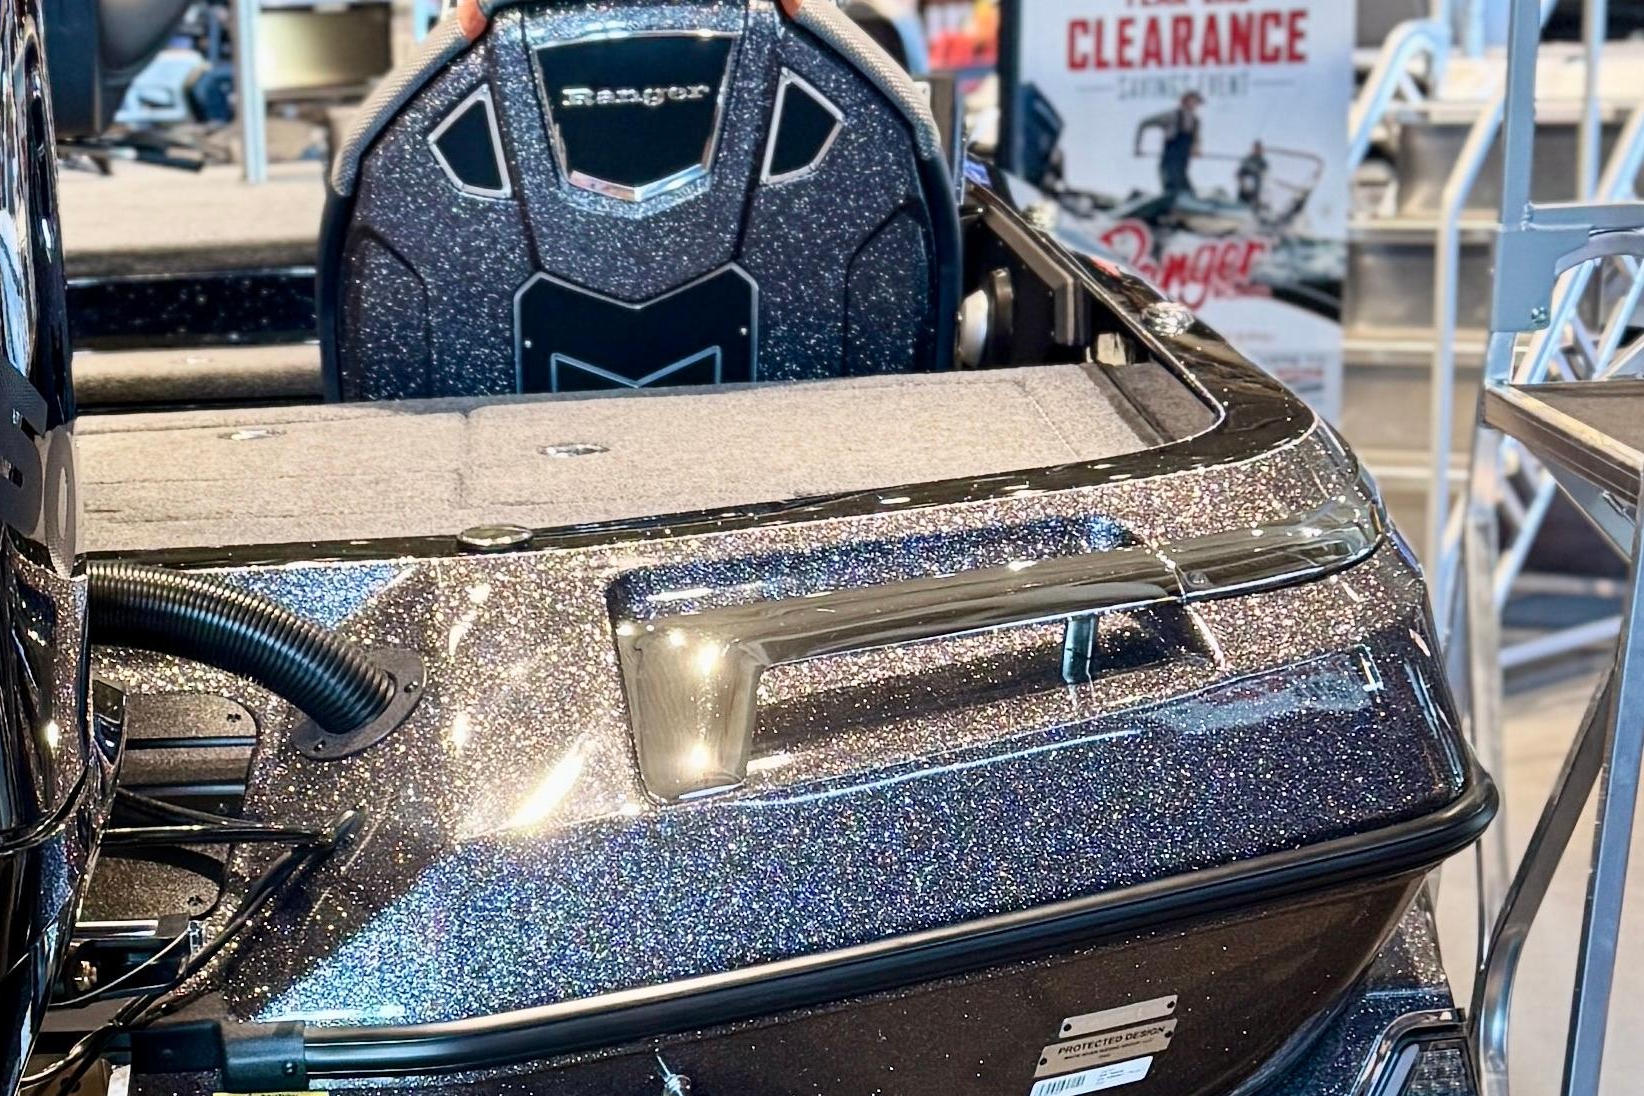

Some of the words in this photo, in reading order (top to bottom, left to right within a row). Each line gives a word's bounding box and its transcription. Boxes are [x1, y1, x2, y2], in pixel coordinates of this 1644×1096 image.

[1067, 8, 1308, 71] CLEARANCE
[562, 84, 710, 107] Ranger
[1057, 1036, 1123, 1055] PROTECTED
[1124, 1026, 1167, 1041] DESIGN
